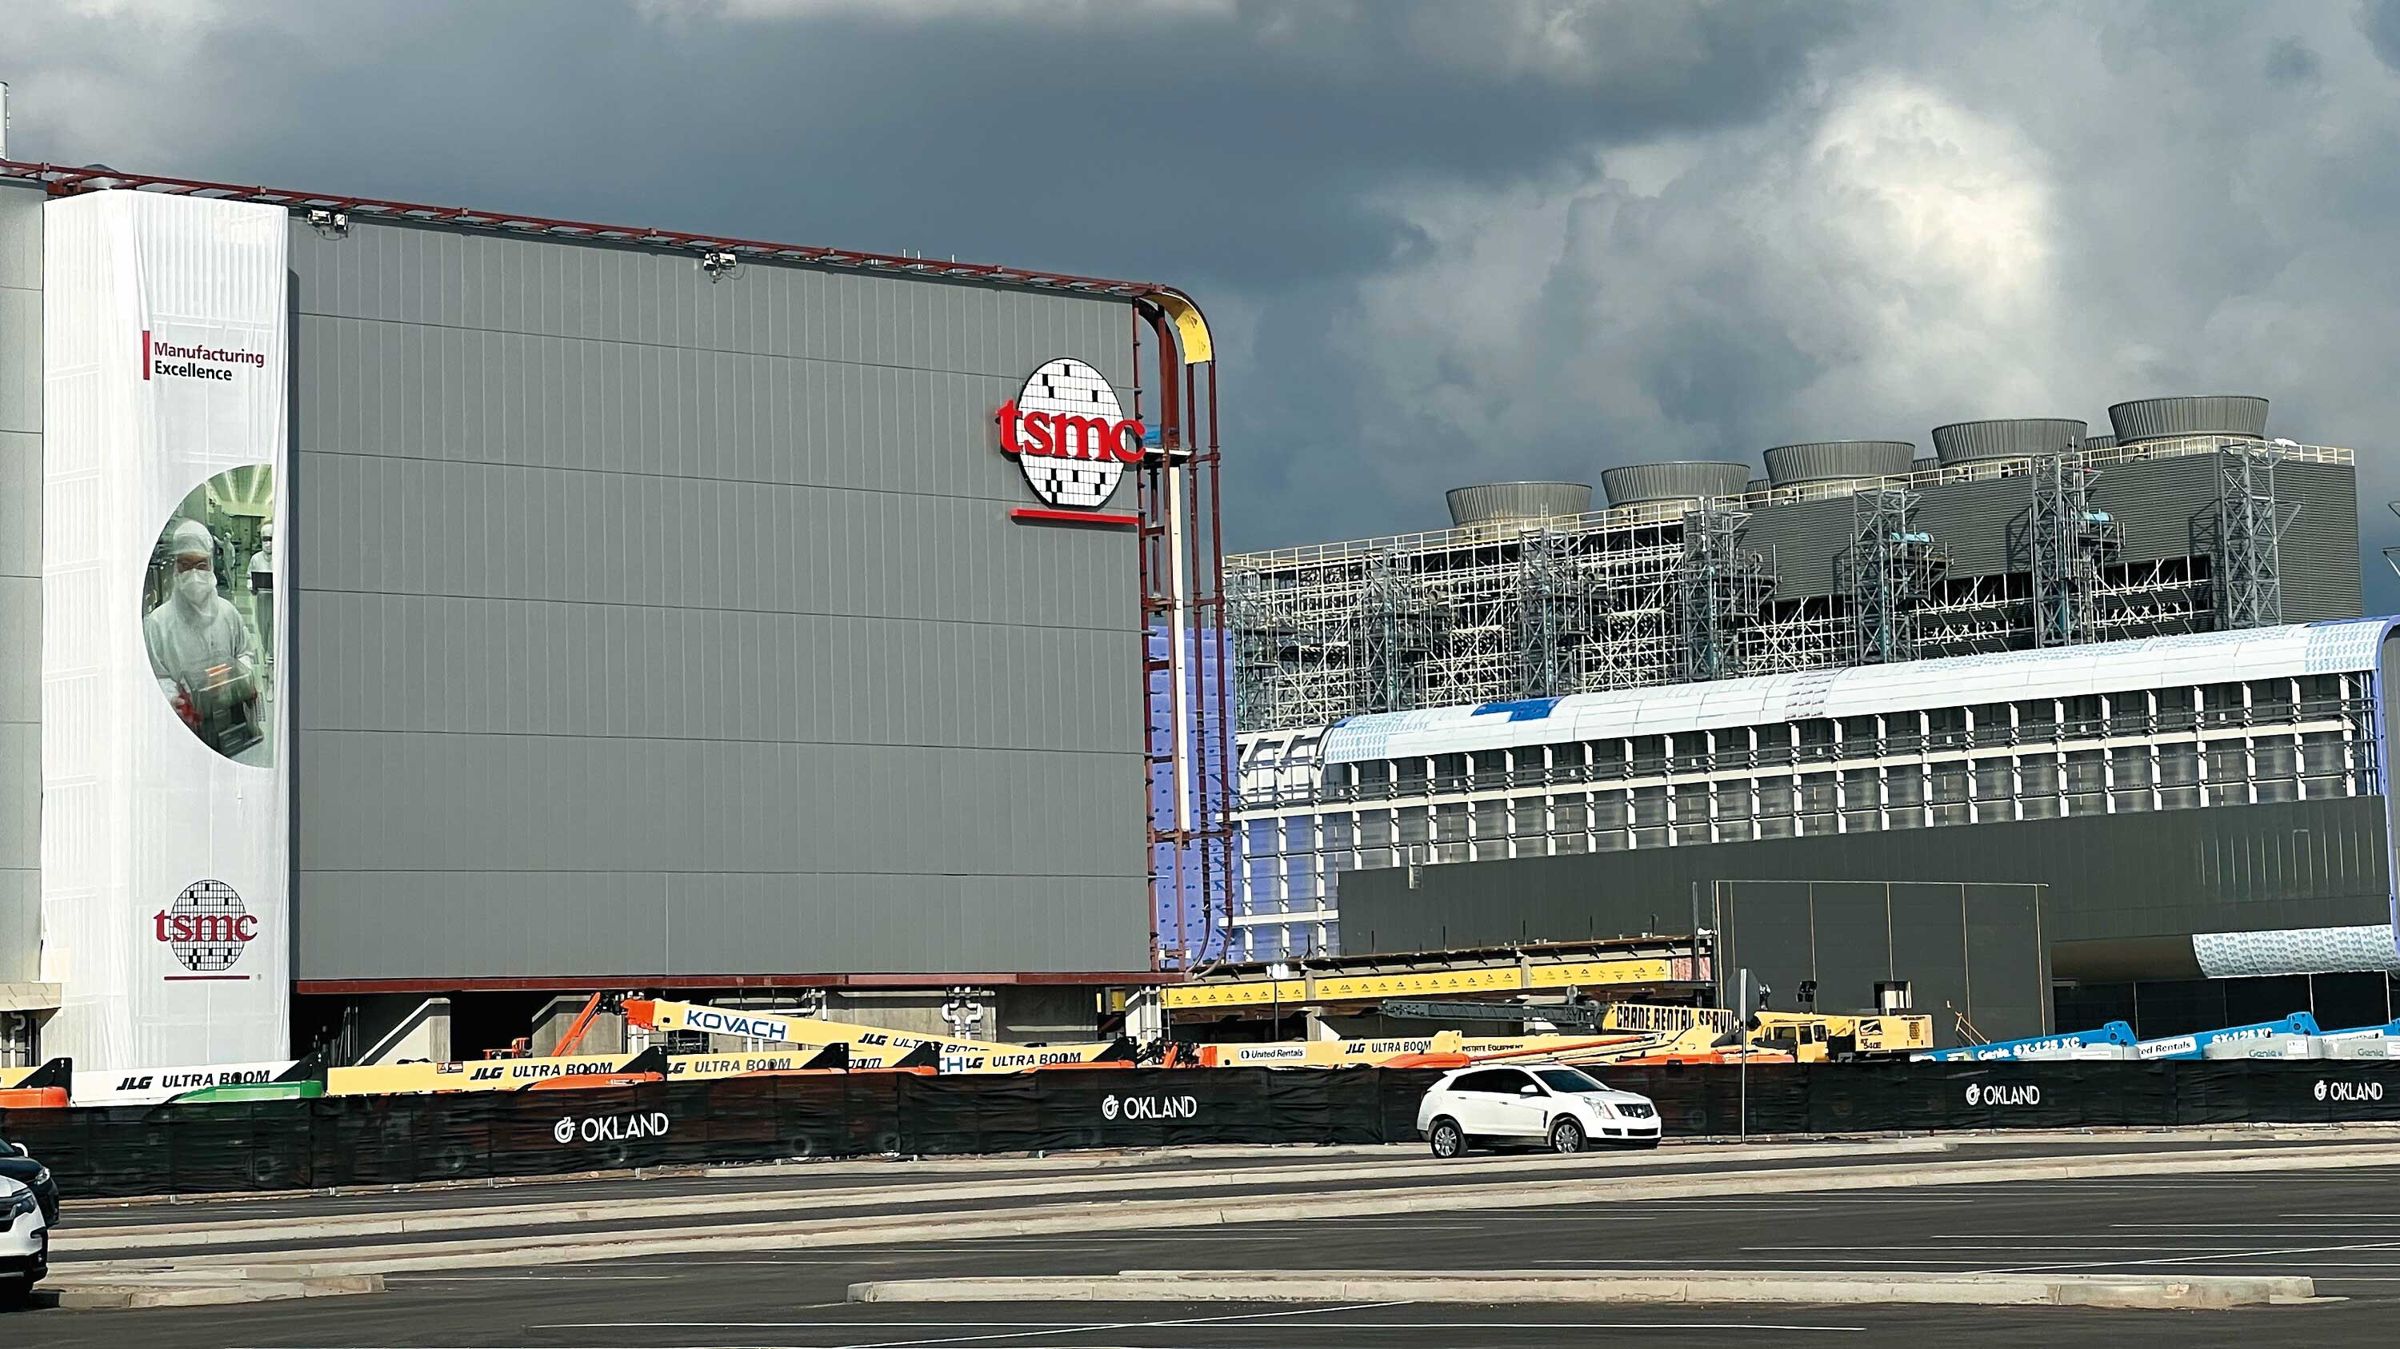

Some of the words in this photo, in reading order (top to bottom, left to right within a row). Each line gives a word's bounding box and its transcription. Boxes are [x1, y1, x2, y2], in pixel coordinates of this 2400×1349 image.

[154, 341, 264, 368] Manufacturing
[155, 360, 232, 380] Excellence
[996, 399, 1146, 463] tsmc
[153, 909, 258, 942] tsmc
[686, 1009, 787, 1040] KOVACH
[1616, 1005, 1650, 1030] CRANE
[858, 1033, 888, 1046] JLG
[1345, 1043, 1366, 1054] JLG
[1371, 1042, 1401, 1053] ULTRA
[1403, 1040, 1431, 1052] BOOM
[2155, 1041, 2191, 1053] Rentals
[966, 1057, 985, 1069] LG
[992, 1054, 1035, 1067] ULTRA
[1039, 1052, 1081, 1064] BOOM
[1251, 1049, 1276, 1059] United
[1277, 1048, 1303, 1057] Rentals
[469, 1066, 504, 1081] JLG
[512, 1064, 561, 1078] ULTRA
[565, 1061, 613, 1076] BOOM
[667, 1062, 687, 1074] LG
[694, 1060, 741, 1073] ULTRA
[746, 1058, 791, 1070] BOOM
[116, 1076, 153, 1091] JLG
[162, 1072, 214, 1088] ULTRA
[218, 1069, 270, 1086] BOOM
[1983, 1085, 2040, 1106] OKLAND
[2330, 1082, 2383, 1101] OKLAND
[1123, 1095, 1197, 1119] OKLAND
[581, 1112, 669, 1142] OKLAND
